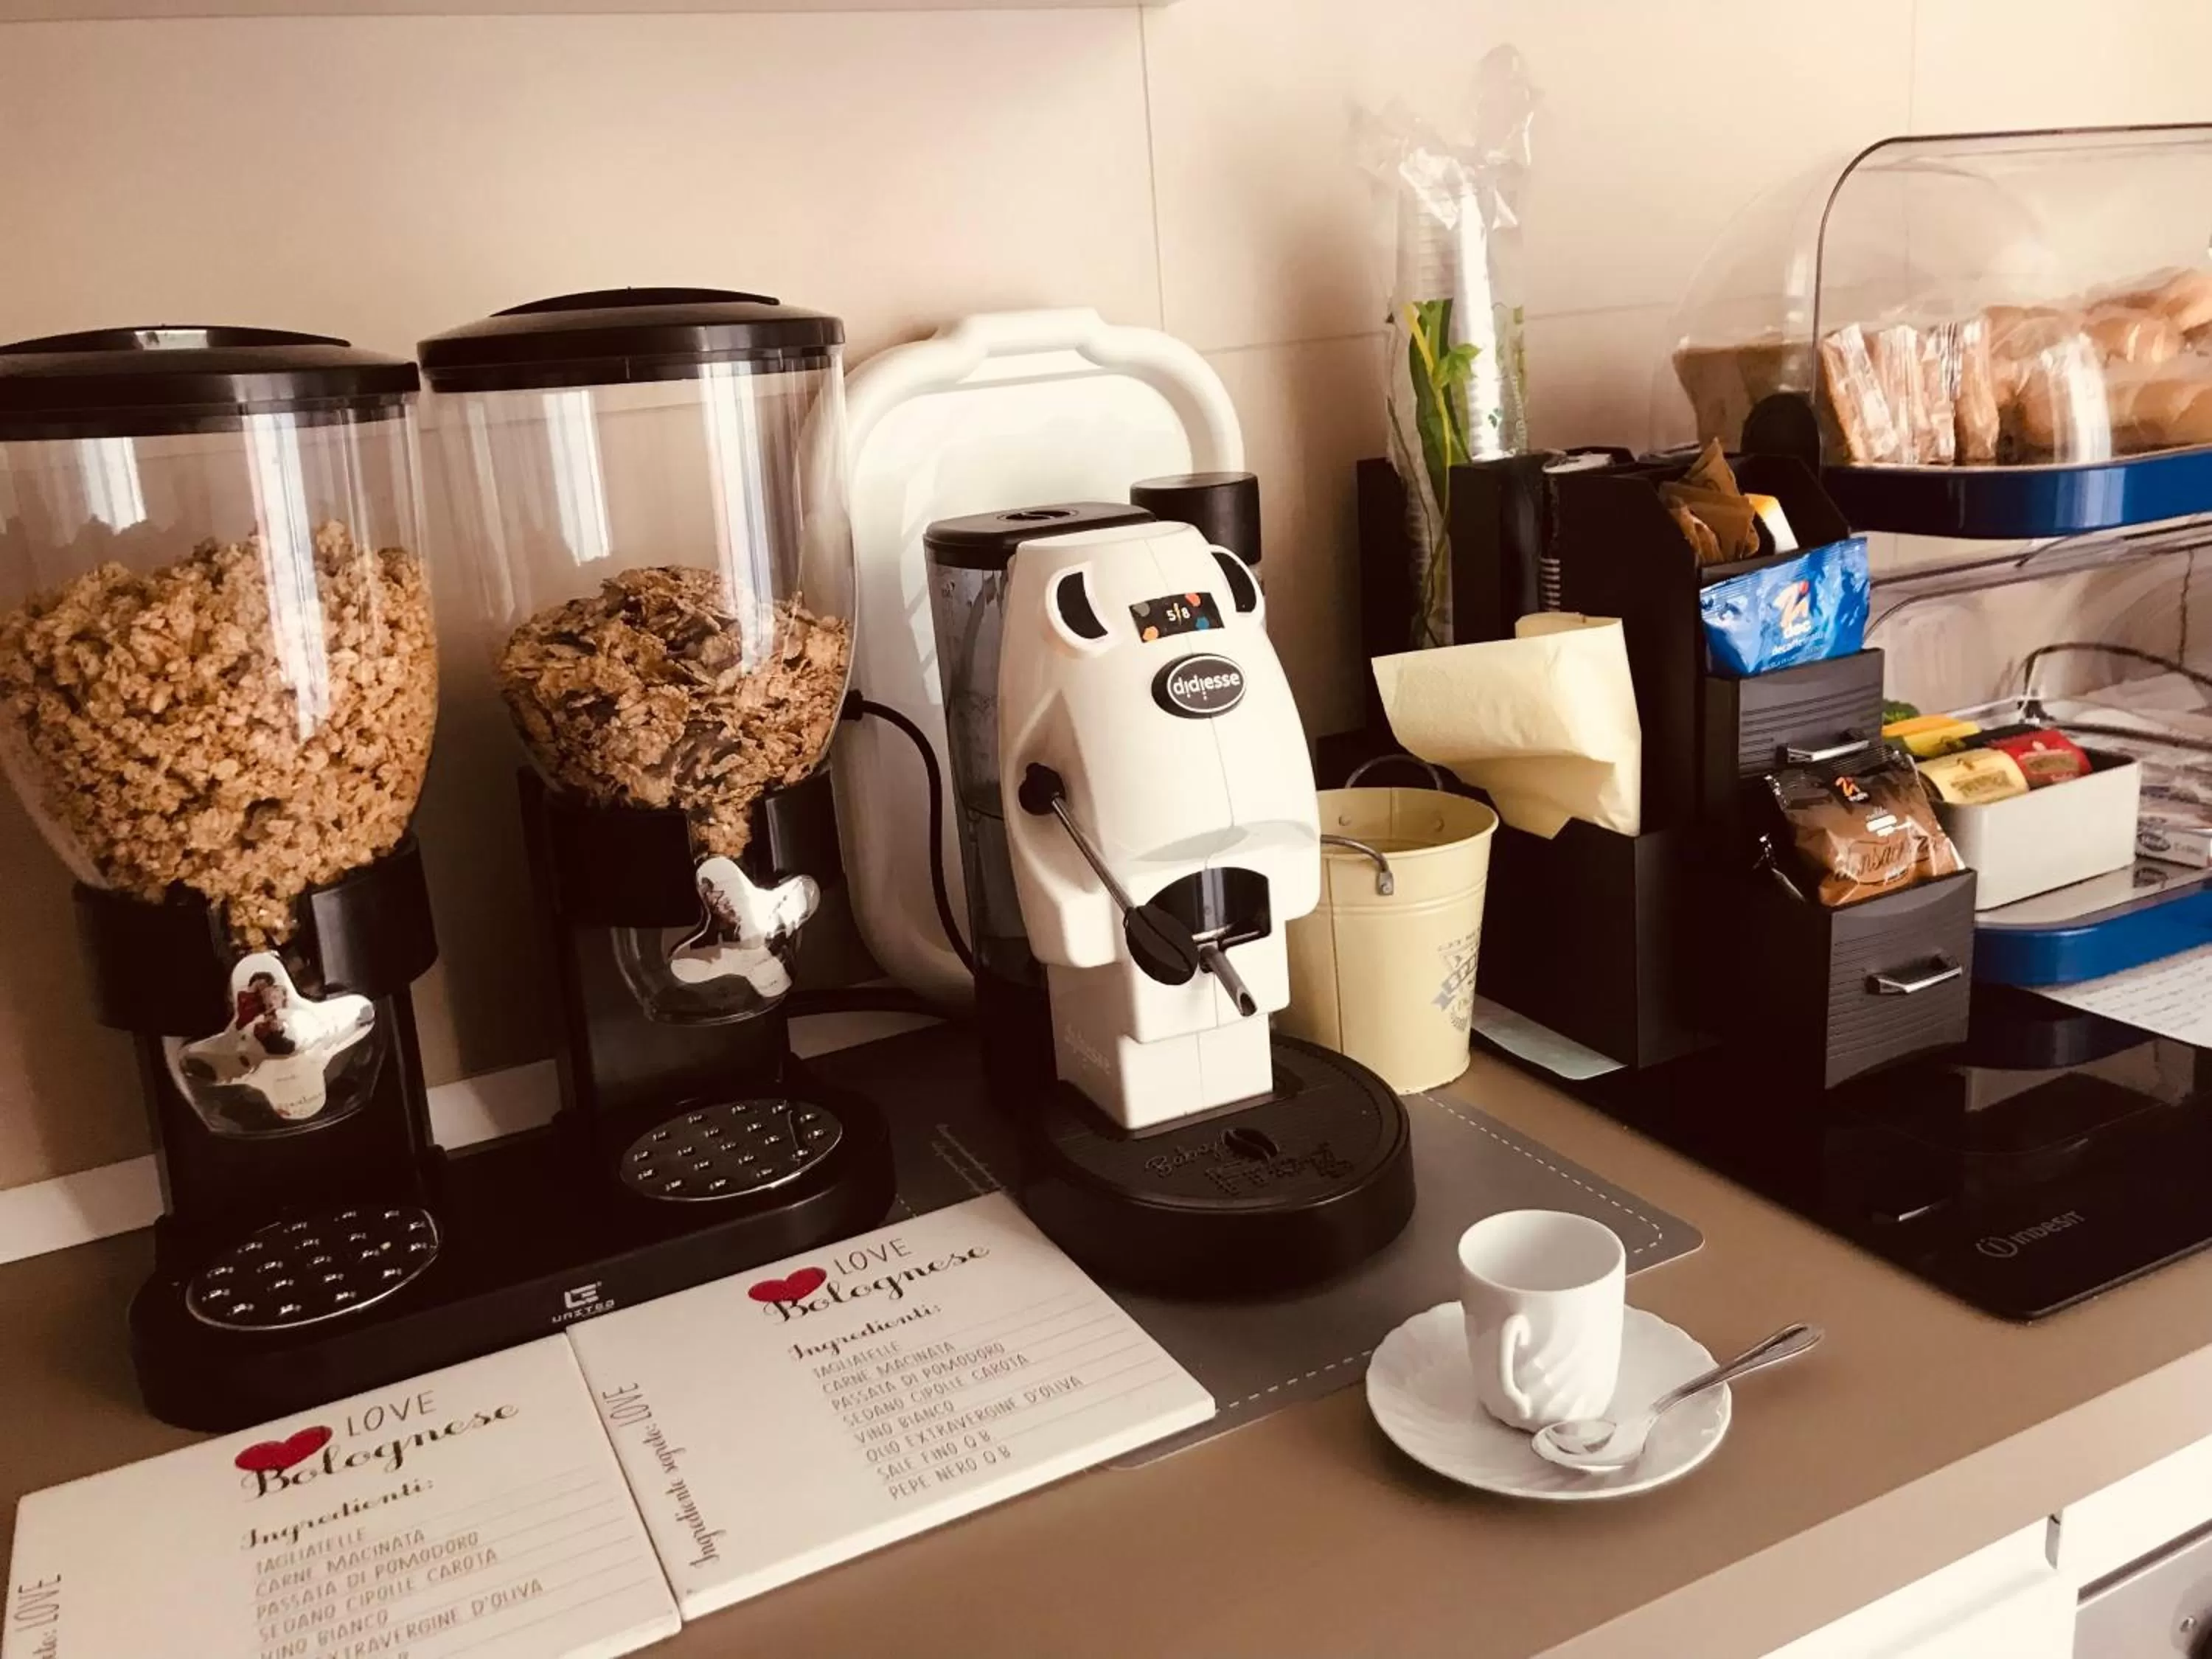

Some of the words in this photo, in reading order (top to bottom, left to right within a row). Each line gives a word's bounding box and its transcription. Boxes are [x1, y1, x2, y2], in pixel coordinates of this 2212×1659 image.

[1173, 672, 1241, 700] didiesse
[834, 1238, 913, 1275] LOVE
[763, 1246, 990, 1325] Bolognese
[813, 1340, 900, 1380] TAGLIATELLE
[822, 1368, 869, 1394] CARNE
[876, 1341, 956, 1377] MACINATA
[831, 1381, 897, 1411] PASSATA
[900, 1372, 919, 1388] DI
[924, 1342, 1006, 1379] POMODORO
[347, 1389, 437, 1437] LOVE
[602, 1382, 652, 1427] LOVE
[843, 1397, 905, 1427] SEDANO
[910, 1375, 964, 1403] CIPOLLE
[971, 1352, 1030, 1381] CAROTA
[853, 1422, 893, 1444] VINO
[897, 1399, 955, 1429] BIANCO
[866, 1440, 901, 1464] OLIO
[904, 1397, 1018, 1447] EXTRAVERGINE
[1023, 1374, 1083, 1404] D'OLIVA
[240, 1403, 518, 1503] Bolognese
[877, 1456, 915, 1481] SALE
[921, 1441, 958, 1464] FINO
[888, 1474, 931, 1501] PEPE
[935, 1456, 978, 1483] NERO
[255, 1565, 313, 1597] CARNE
[327, 1528, 426, 1573] MACINATA
[256, 1526, 366, 1576] TAGLIATELLE
[256, 1580, 338, 1620] PASSATA
[347, 1573, 366, 1590] DI
[375, 1531, 479, 1582] POMODORO
[13, 1573, 61, 1632] LOVE
[259, 1604, 336, 1644] SEDANO
[346, 1578, 416, 1612] CIPOLLE
[427, 1547, 498, 1583] CAROTA
[316, 1607, 459, 1659] XTRAVERGINE
[471, 1577, 544, 1617] D'OLIVA
[318, 1609, 389, 1647] BIANCO
